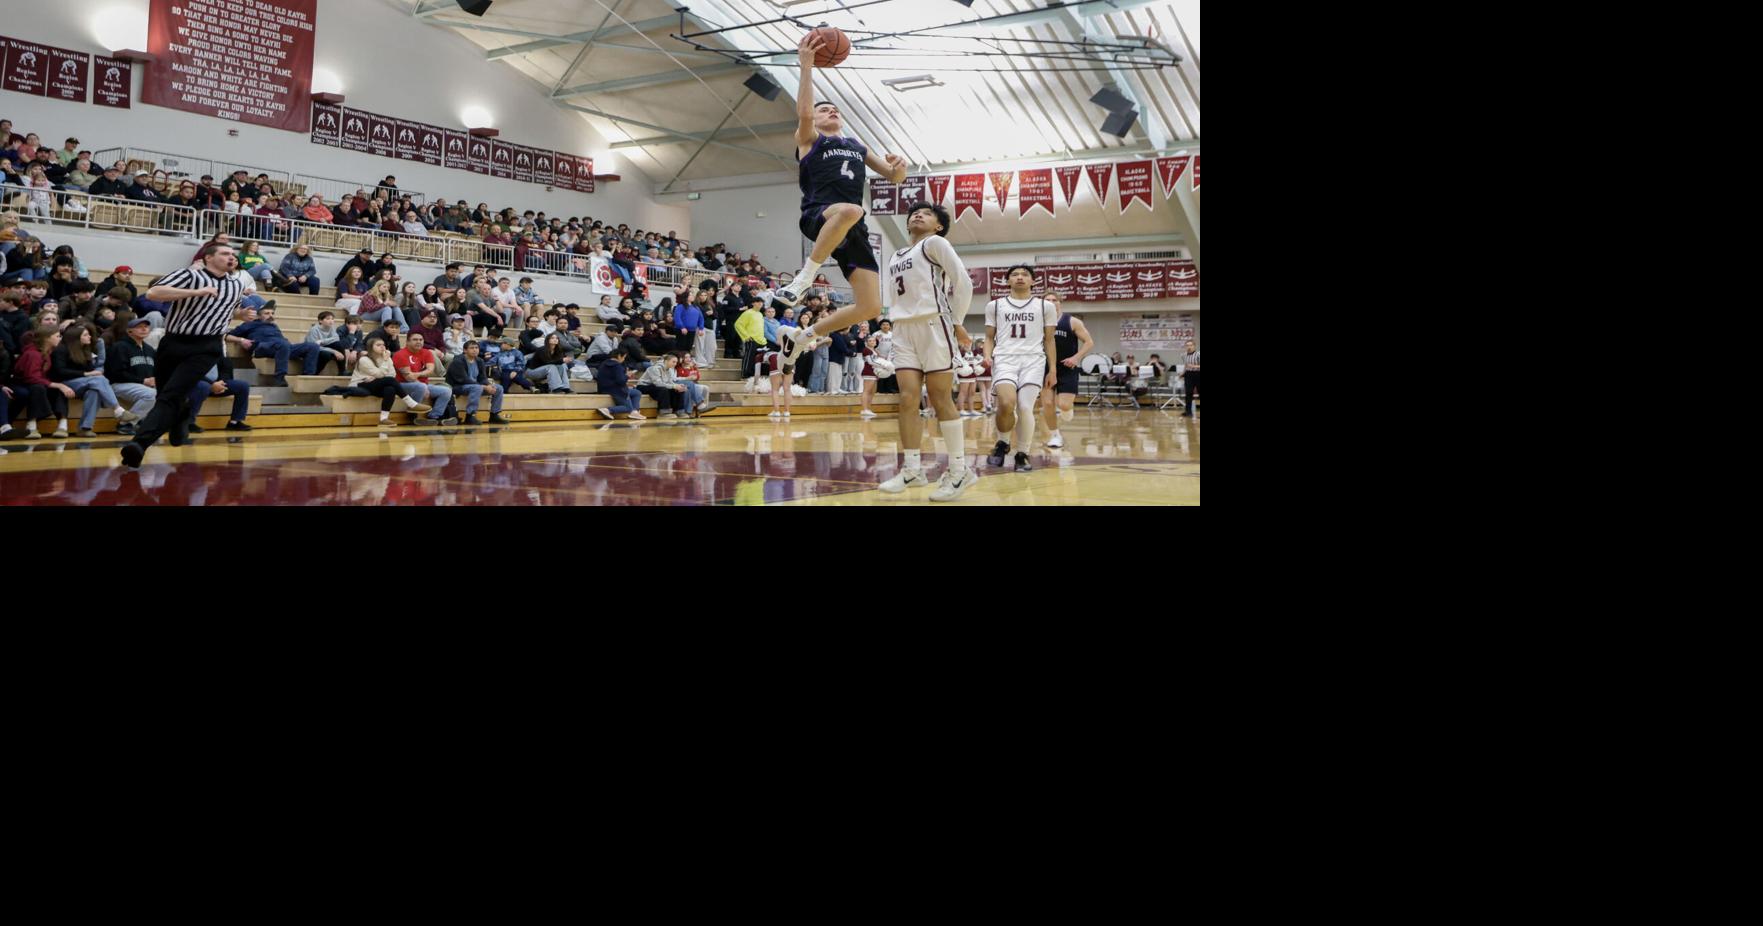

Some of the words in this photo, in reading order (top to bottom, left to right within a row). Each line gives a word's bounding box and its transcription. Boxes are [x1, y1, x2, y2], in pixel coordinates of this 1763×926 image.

[188, 2, 208, 13] PUSH
[208, 7, 219, 16] ON
[220, 10, 230, 18] TO
[230, 13, 260, 27] GREATER
[261, 20, 281, 32] GLORY
[217, 0, 225, 8] TO
[226, 2, 244, 13] KEEP
[244, 8, 258, 17] OUR
[259, 11, 276, 22] TRUE
[276, 16, 299, 28] COLORS
[255, 1, 273, 12] DEAR
[274, 6, 287, 16] OLD
[171, 6, 182, 16] SO
[183, 9, 202, 20] THAT
[203, 14, 218, 25] HER
[219, 18, 242, 31] HONOR
[243, 24, 259, 35] MAY
[260, 29, 281, 41] NEVER
[187, 19, 206, 31] THEN
[207, 24, 224, 35] SING
[224, 29, 231, 37] A
[231, 31, 250, 42] SONG
[250, 35, 260, 43] TO
[10, 41, 48, 56] Wrestling
[178, 26, 190, 37] WE
[191, 30, 209, 41] GIVE
[209, 34, 233, 47] HONOR
[233, 40, 252, 51] UNTO
[253, 45, 267, 55] HER
[268, 48, 288, 60] NAME
[187, 38, 211, 50] PROUD
[212, 44, 227, 54] HER
[227, 47, 252, 60] COLORS
[253, 54, 279, 66] WAVING
[52, 49, 88, 63] Wrestling
[96, 57, 130, 70] Wrestling
[169, 42, 193, 56] EVERY
[194, 49, 223, 62] BANNER
[224, 55, 241, 66] WILL
[242, 60, 258, 71] TELL
[259, 64, 273, 74] HER
[8, 75, 42, 87] Champions
[52, 81, 84, 91] Champions
[172, 62, 203, 77] MAROON
[203, 69, 219, 80] AND
[220, 73, 243, 85] WHITE
[244, 79, 259, 88] ARE
[259, 82, 289, 95] FIGHTING
[185, 75, 196, 85] TO
[197, 78, 219, 90] BRING
[219, 82, 240, 94] HOME
[240, 86, 247, 95] A
[247, 88, 276, 101] VICTORY
[97, 89, 128, 98] Champions
[171, 81, 184, 91] WE
[185, 84, 212, 98] PLEDGE
[212, 91, 227, 101] OUR
[228, 93, 255, 106] HEARTS
[255, 98, 266, 108] TO
[181, 93, 198, 104] AND
[199, 97, 231, 111] FOREVER
[231, 103, 246, 113] OUR
[314, 102, 341, 114] Wrestling
[343, 108, 369, 119] Wrestling
[370, 114, 395, 126] Wrestling
[840, 160, 855, 180] 4
[895, 275, 906, 296] 3
[1004, 312, 1035, 322] KINGS
[1010, 323, 1026, 339] 11
